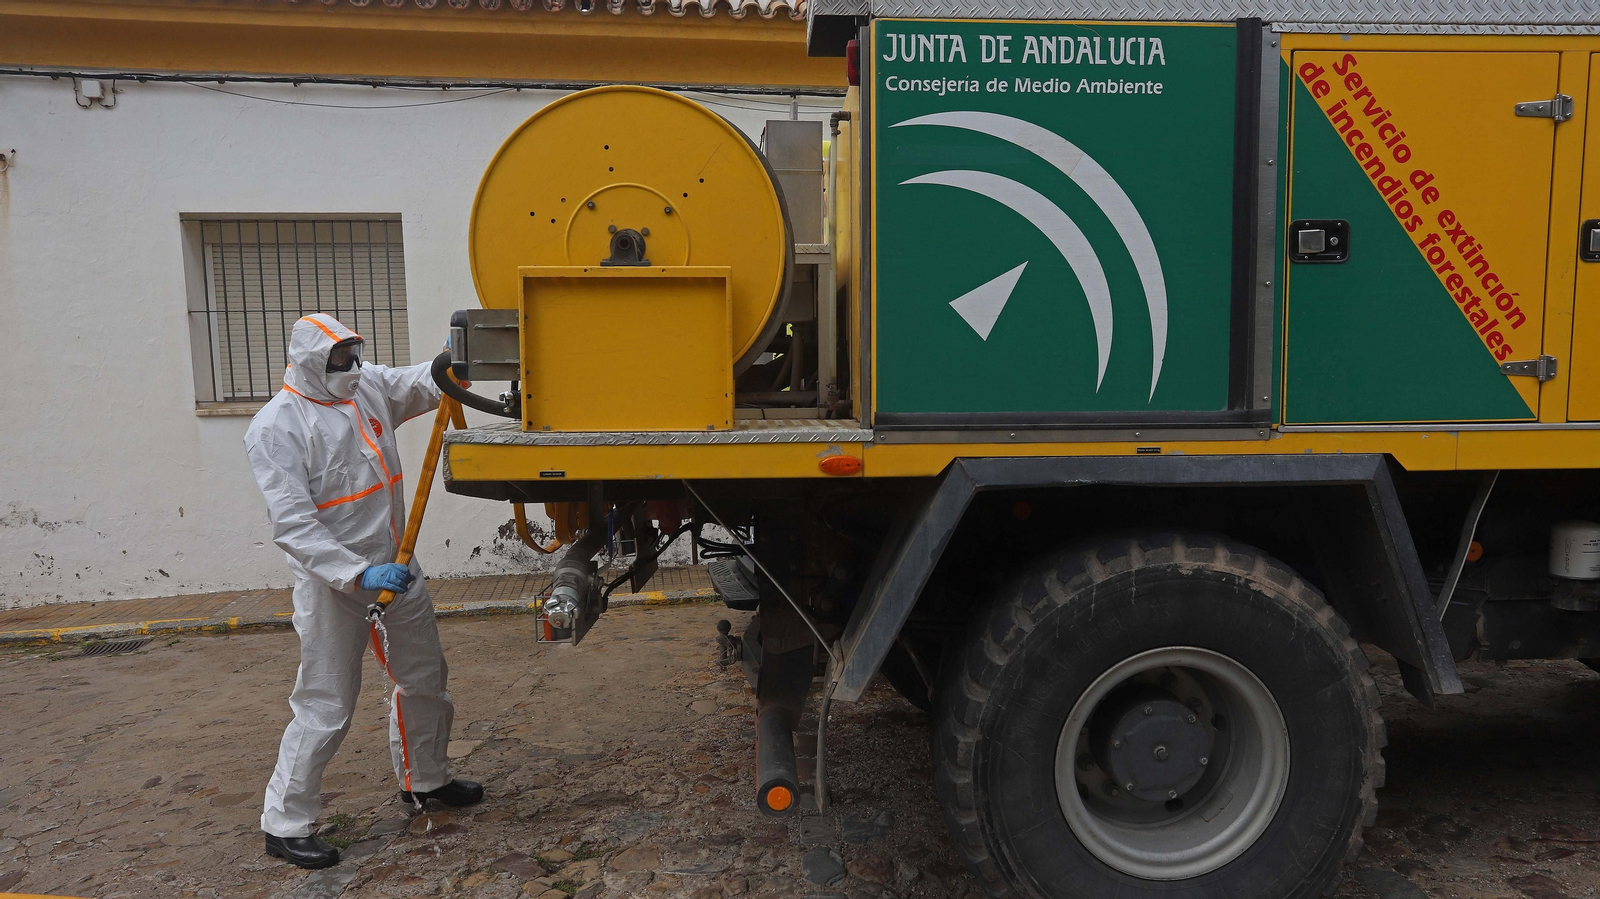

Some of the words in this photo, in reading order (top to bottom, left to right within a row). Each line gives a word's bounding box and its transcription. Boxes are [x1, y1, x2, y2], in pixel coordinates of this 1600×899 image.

[882, 33, 967, 63] JUNTA
[979, 34, 1013, 64] DE
[1021, 35, 1166, 66] ANDALUCIA
[885, 75, 980, 97] Consejería
[985, 77, 1009, 93] de
[1014, 77, 1071, 94] Medio
[1075, 78, 1164, 95] Ambiente
[1298, 61, 1331, 100] de
[1325, 98, 1424, 233] incendios
[1417, 232, 1514, 362] forestales
[1331, 53, 1412, 164] Servicio
[1409, 168, 1440, 206] de
[1436, 208, 1527, 331] extinción
[1019, 617, 1123, 735] MICHELIN
